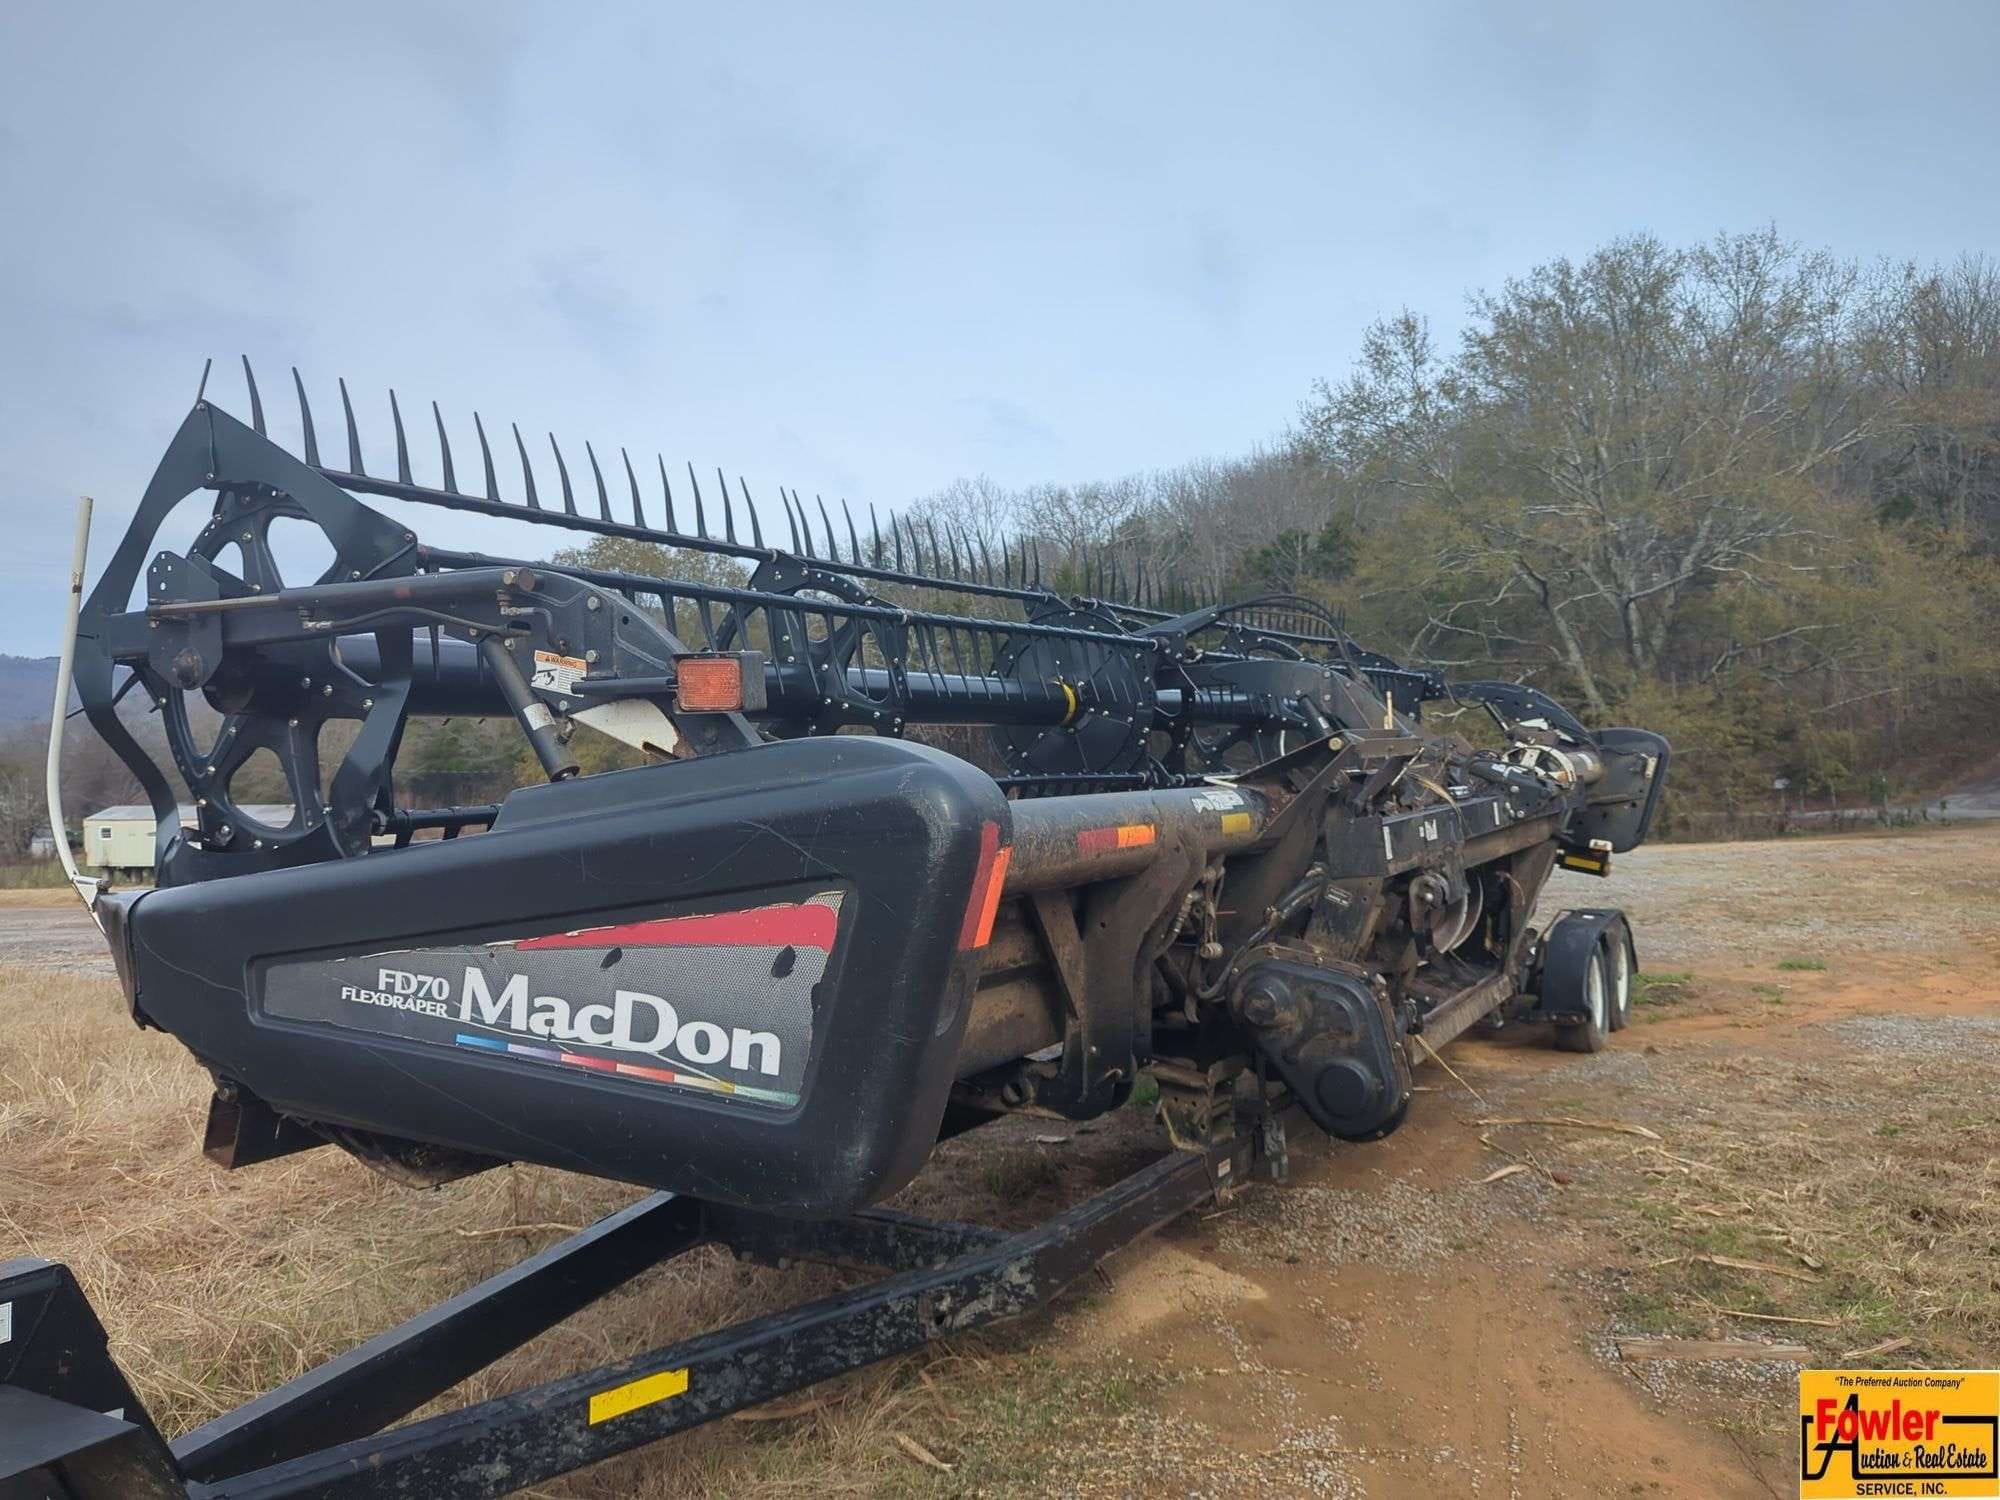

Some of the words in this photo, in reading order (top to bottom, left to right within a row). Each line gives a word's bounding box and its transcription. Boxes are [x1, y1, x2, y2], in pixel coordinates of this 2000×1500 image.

[378, 968, 450, 1001] FD70
[341, 986, 449, 1018] FLEXDRAPER
[459, 966, 782, 1075] MacDon
